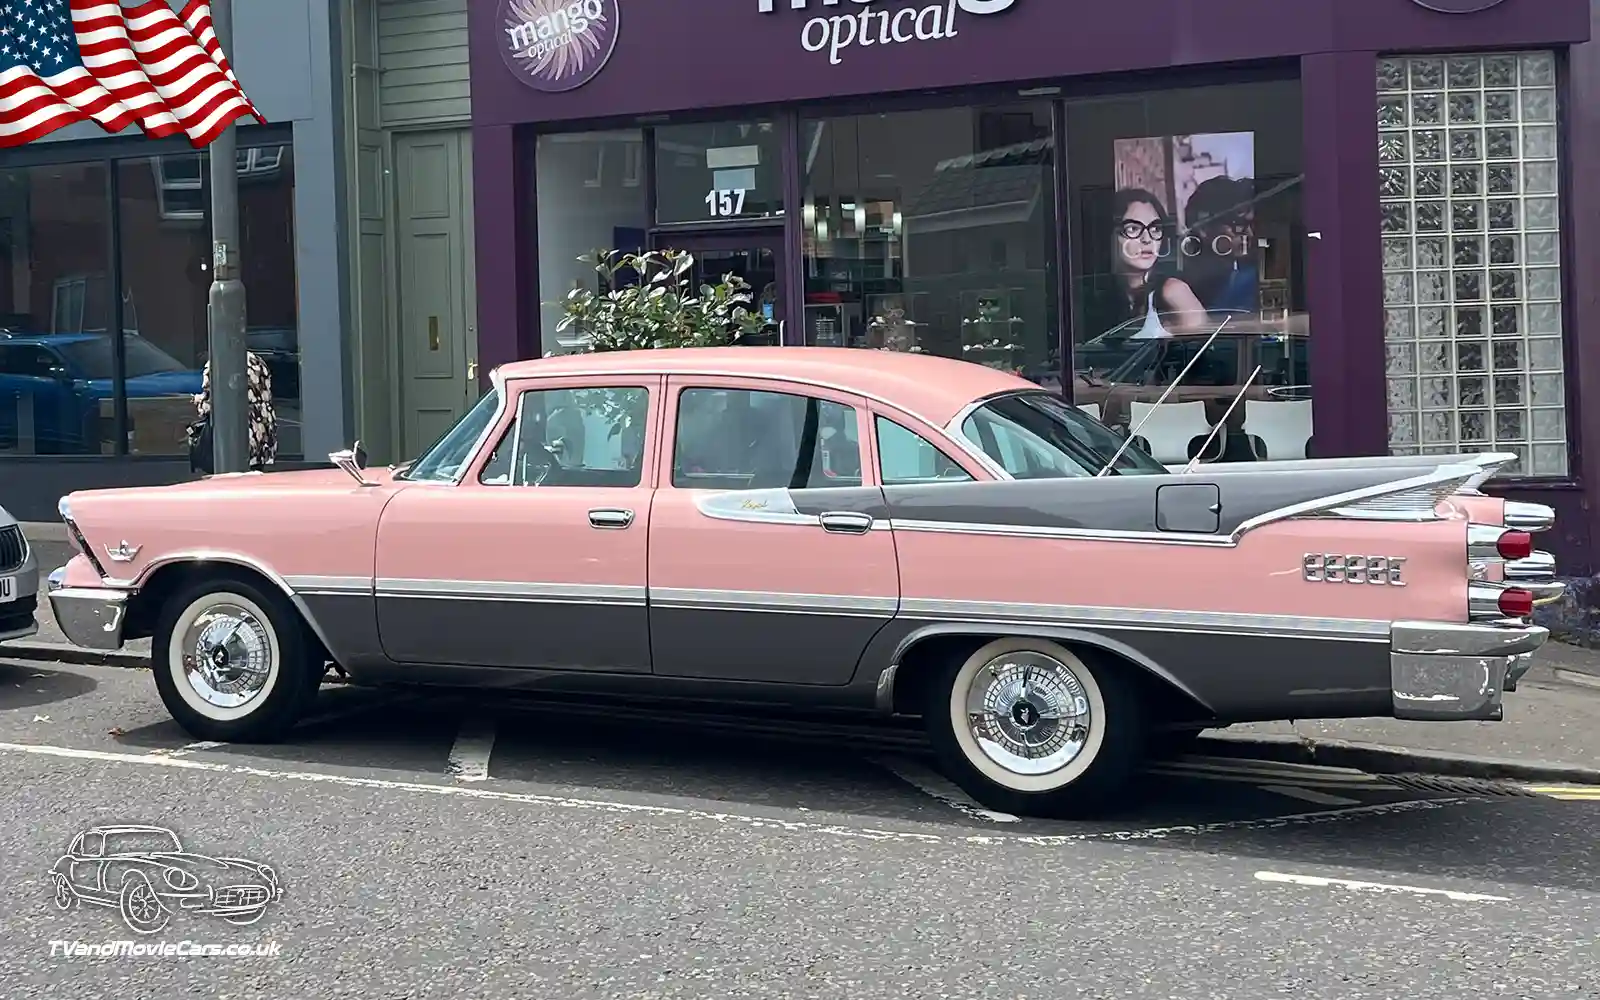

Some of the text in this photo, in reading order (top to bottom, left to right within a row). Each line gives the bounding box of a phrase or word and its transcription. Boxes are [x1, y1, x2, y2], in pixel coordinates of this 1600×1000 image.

[509, 0, 602, 49] mango
[528, 29, 572, 59] optical
[801, 0, 957, 64] optical
[705, 188, 746, 216] 157
